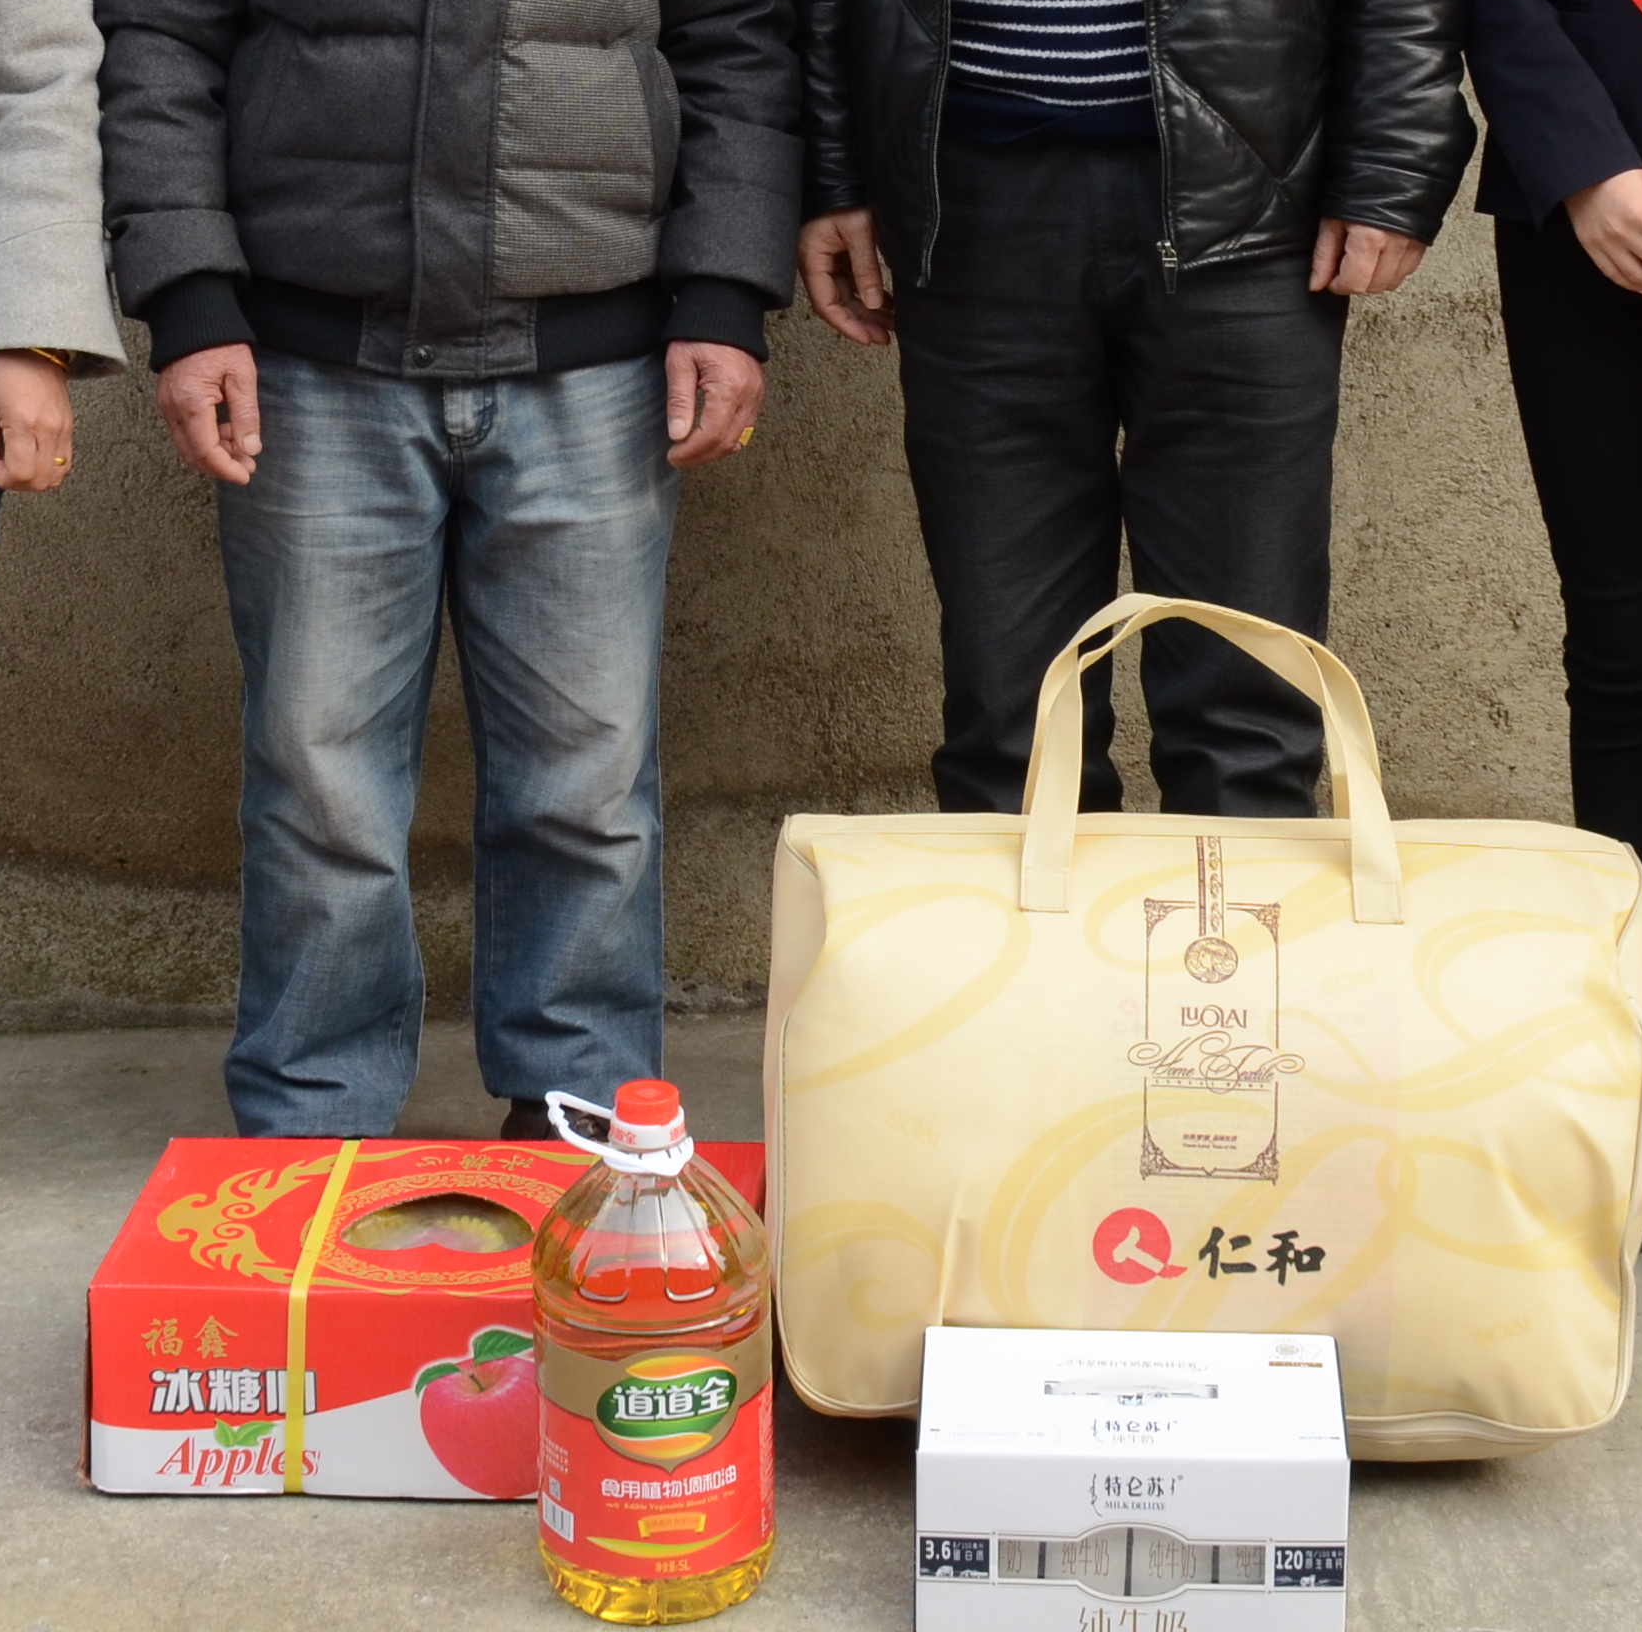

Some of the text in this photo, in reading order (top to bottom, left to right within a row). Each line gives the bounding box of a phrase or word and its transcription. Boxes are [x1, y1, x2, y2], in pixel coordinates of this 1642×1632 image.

[1181, 1005, 1248, 1029] LUOLAI
[1199, 1226, 1326, 1287] 仁和
[141, 1315, 239, 1359] 福鑫
[613, 1376, 730, 1421] 道道全
[156, 1435, 321, 1487] Apples
[601, 1464, 738, 1500] 食用植物调和油
[1104, 1474, 1165, 1498] 特仑苏
[649, 1501, 685, 1511] Vegetable
[1104, 1500, 1166, 1511] MILK DELUXE
[925, 1539, 951, 1561] 3.6
[1061, 1538, 1110, 1577] 纯牛奶
[1148, 1540, 1197, 1580] 纯牛奶
[1275, 1549, 1304, 1570] 120
